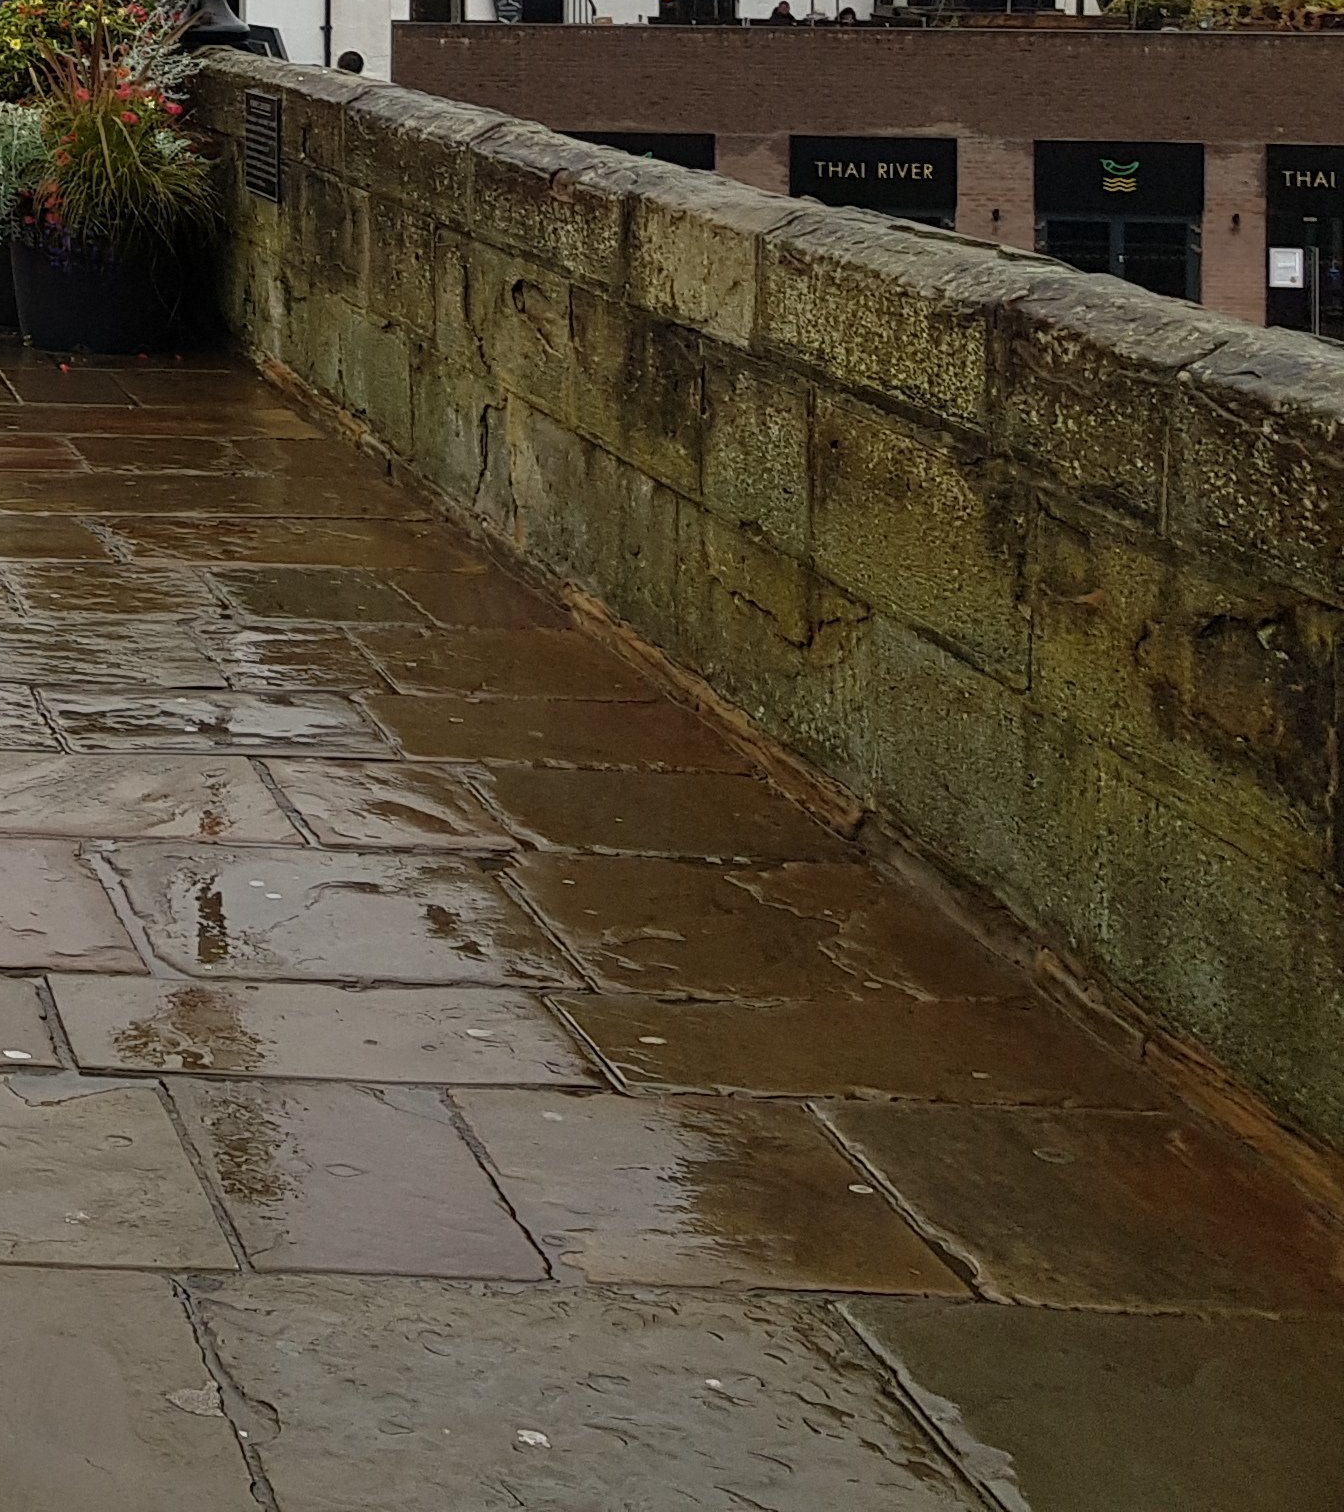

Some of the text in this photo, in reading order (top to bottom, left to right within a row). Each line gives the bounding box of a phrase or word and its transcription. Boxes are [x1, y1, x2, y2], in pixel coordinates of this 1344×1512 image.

[814, 161, 934, 179] THAI RIVER
[1282, 170, 1337, 188] THAI
